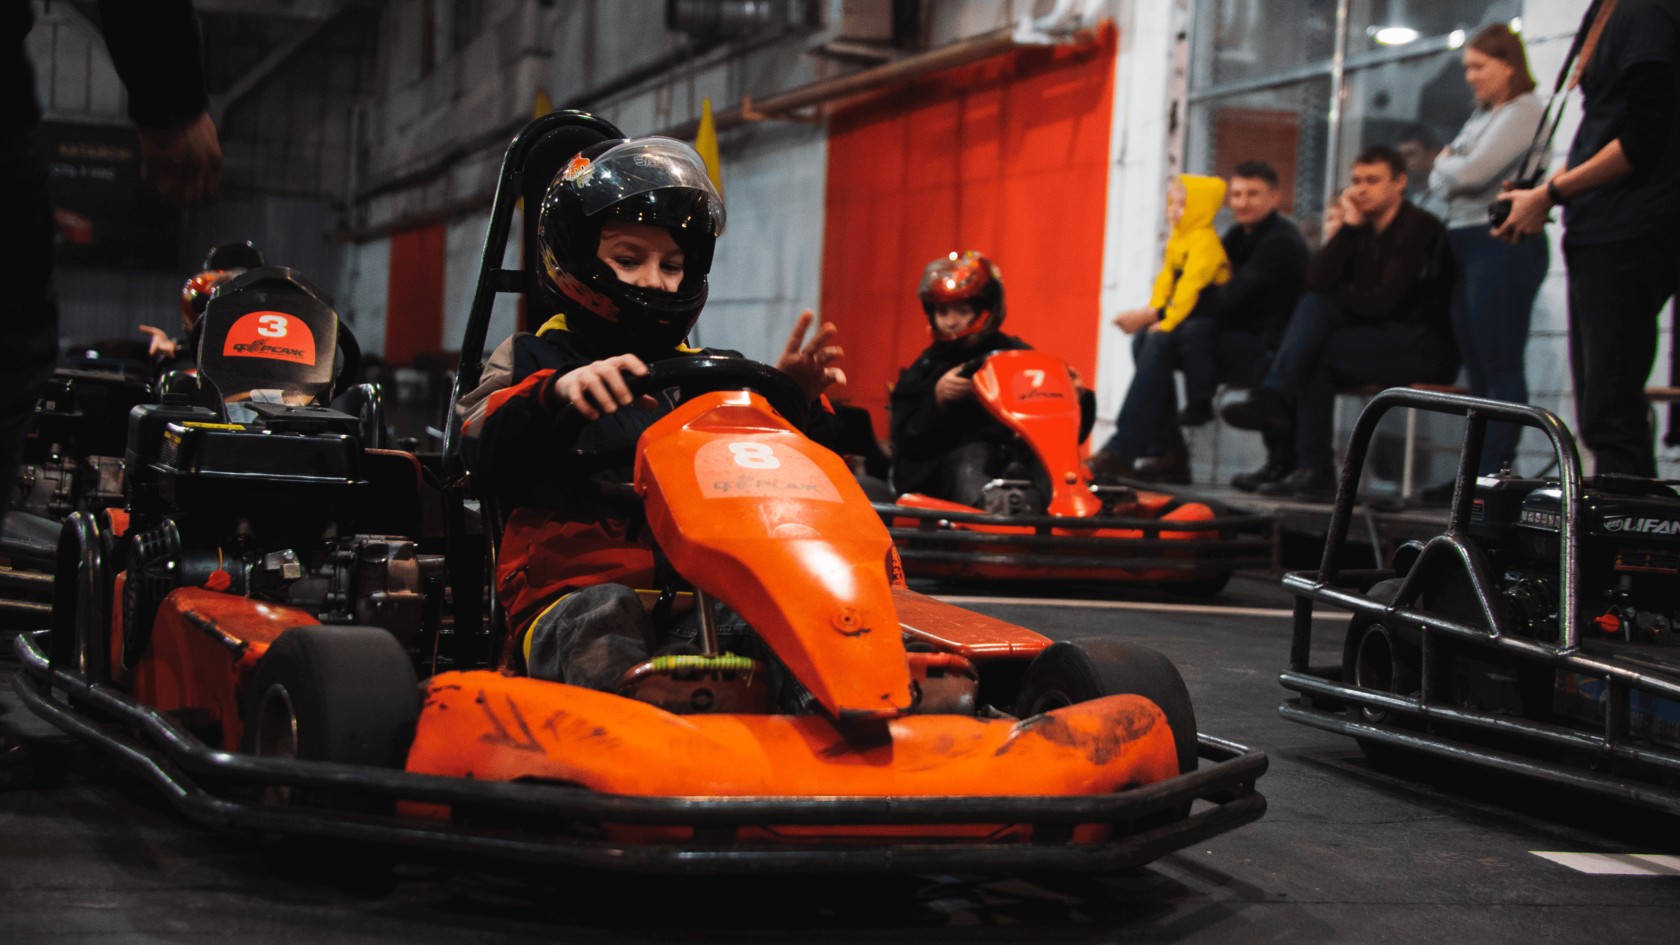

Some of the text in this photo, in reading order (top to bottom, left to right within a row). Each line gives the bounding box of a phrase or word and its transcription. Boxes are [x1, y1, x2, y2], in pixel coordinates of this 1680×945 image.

[257, 315, 288, 338] 3
[1023, 369, 1046, 388] 7
[728, 442, 781, 469] 8
